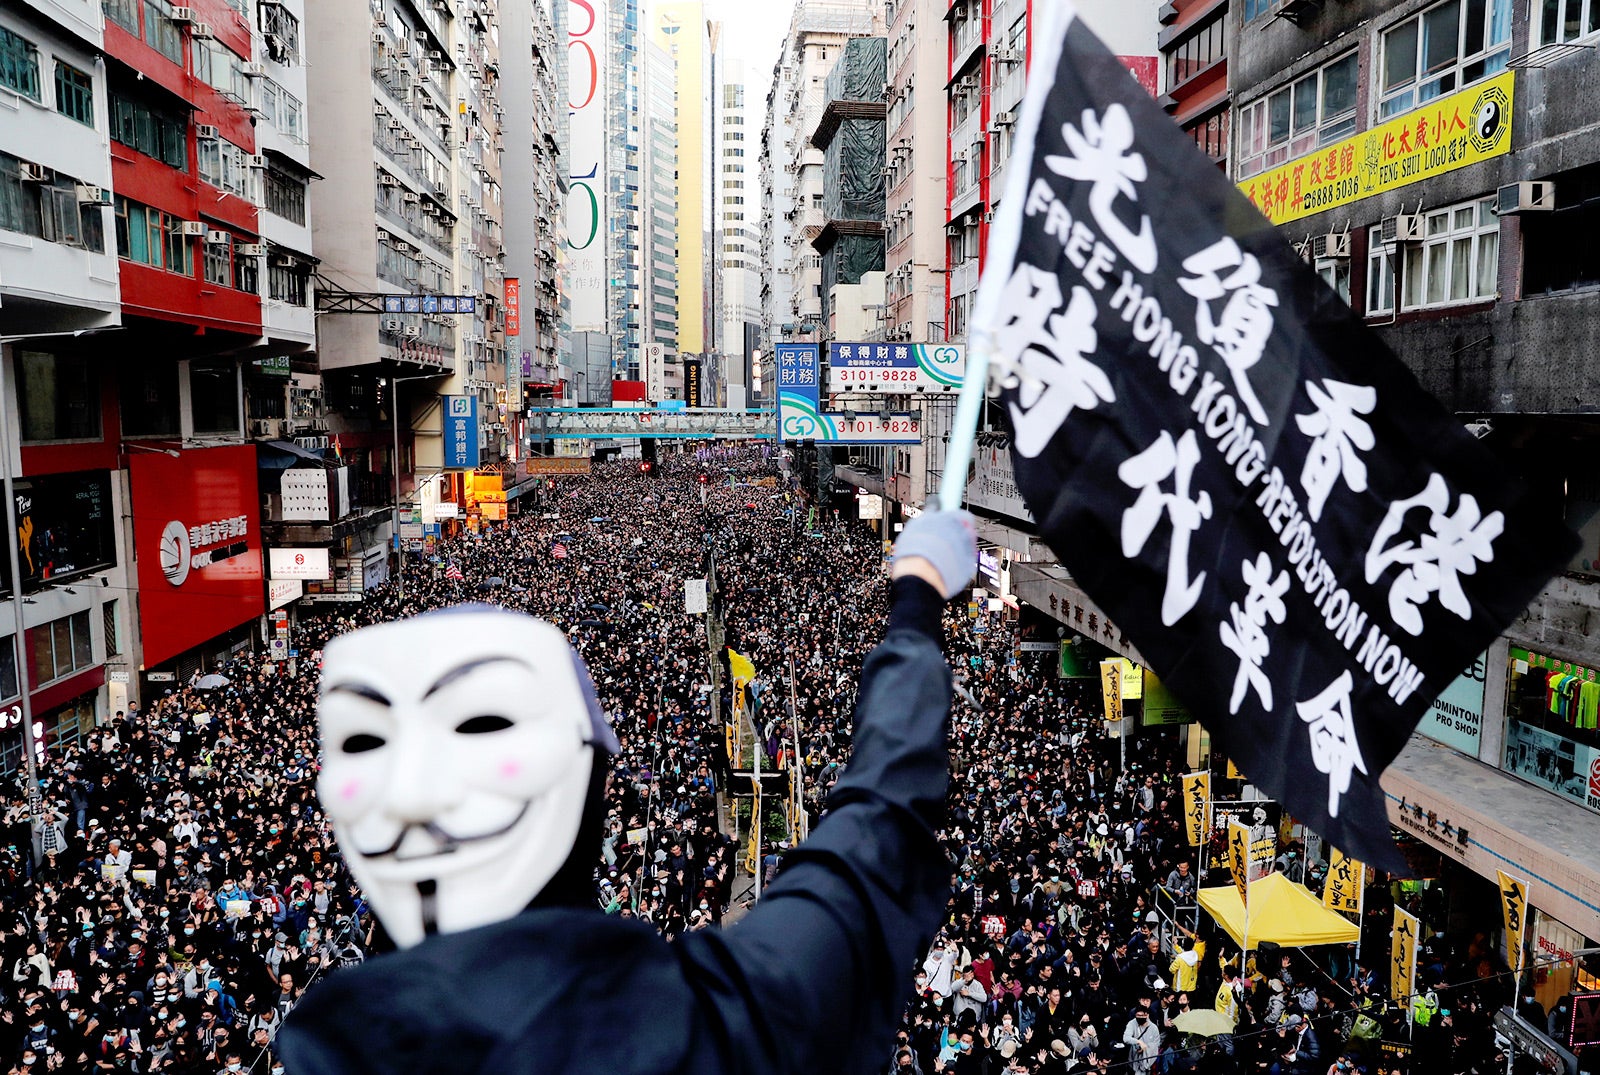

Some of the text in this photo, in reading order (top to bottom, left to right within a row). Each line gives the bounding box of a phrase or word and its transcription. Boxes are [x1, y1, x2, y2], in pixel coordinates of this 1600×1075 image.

[1382, 106, 1466, 162] 化太歲小人
[1309, 144, 1355, 185] 改運館
[1379, 162, 1398, 185] FENG
[1401, 157, 1421, 178] SHUI
[1424, 147, 1447, 173] LOGO
[1311, 175, 1359, 210] 6888 5036
[781, 351, 814, 368] 保得
[839, 345, 908, 359] 保得財務
[781, 368, 815, 385] 財務
[840, 370, 917, 381] 3101-9828
[455, 419, 467, 464] 富邦銀行
[838, 421, 919, 433] 3101-9828
[1025, 177, 1425, 707] FREE HONG KONG REVOLUTION NOW
[1436, 713, 1478, 737] PRO SHOP
